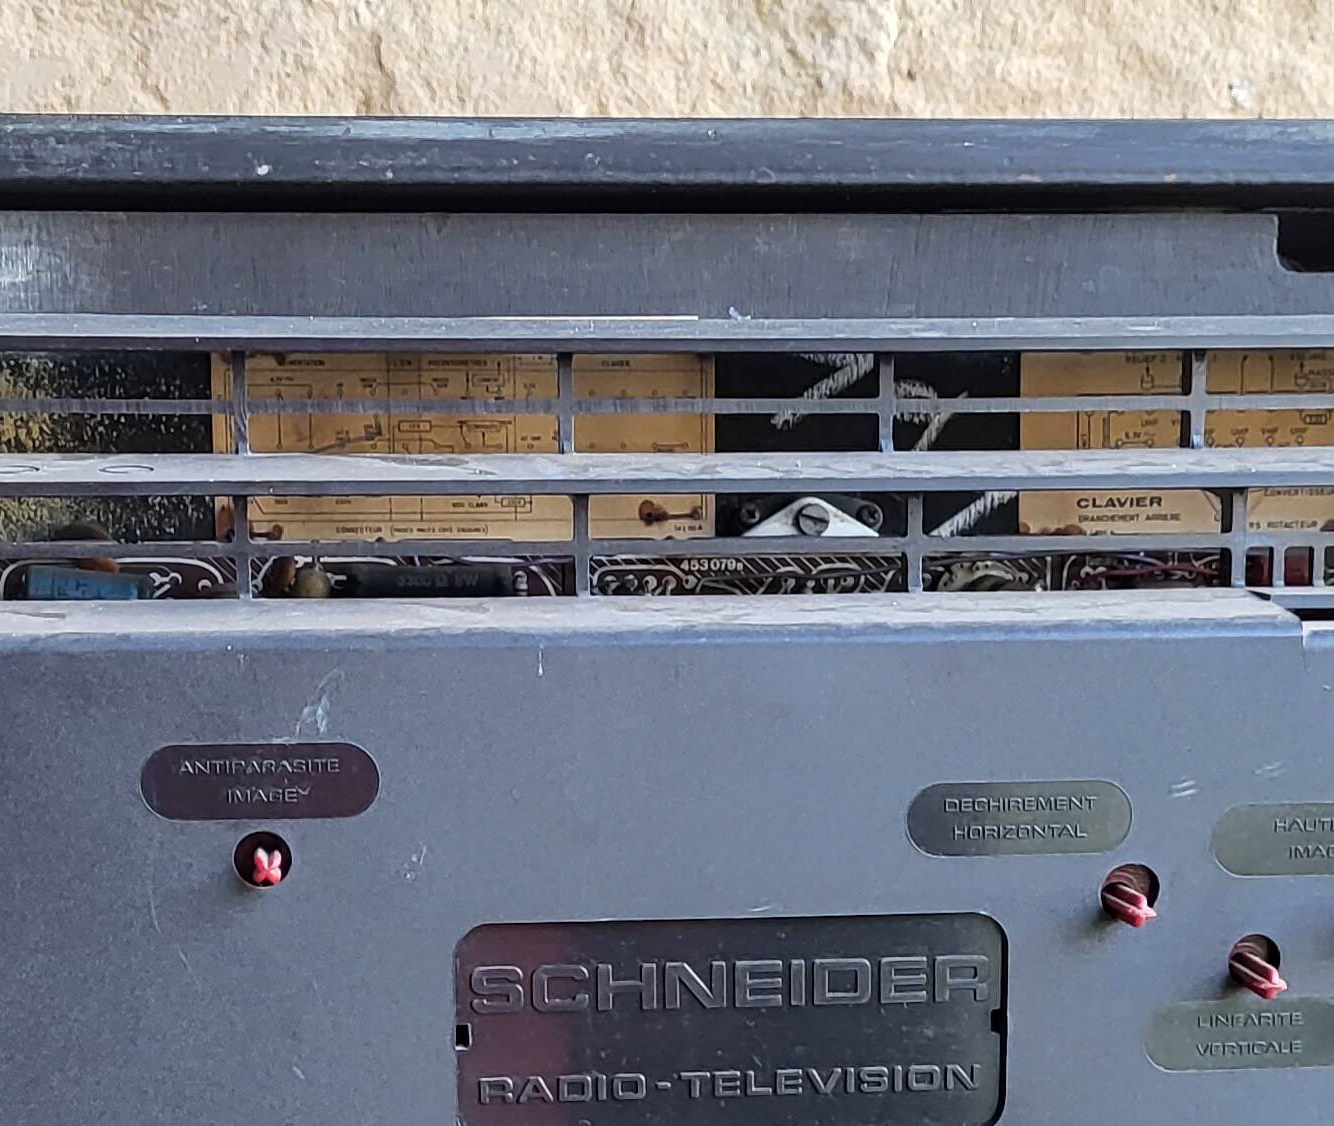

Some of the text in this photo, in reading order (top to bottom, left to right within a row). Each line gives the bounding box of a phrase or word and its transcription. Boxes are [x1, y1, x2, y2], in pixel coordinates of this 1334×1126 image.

[1076, 496, 1163, 509] CLAVIER
[179, 758, 340, 776] ANTIPARASITE
[227, 787, 299, 804] IMAGE
[943, 796, 1097, 813] DECHIREMENT
[953, 824, 1088, 841] HORIZONTAL
[470, 954, 990, 1014] SCHNEIDER
[1197, 1012, 1304, 1028] LINEARITE
[1196, 1040, 1303, 1056] VERTICALE
